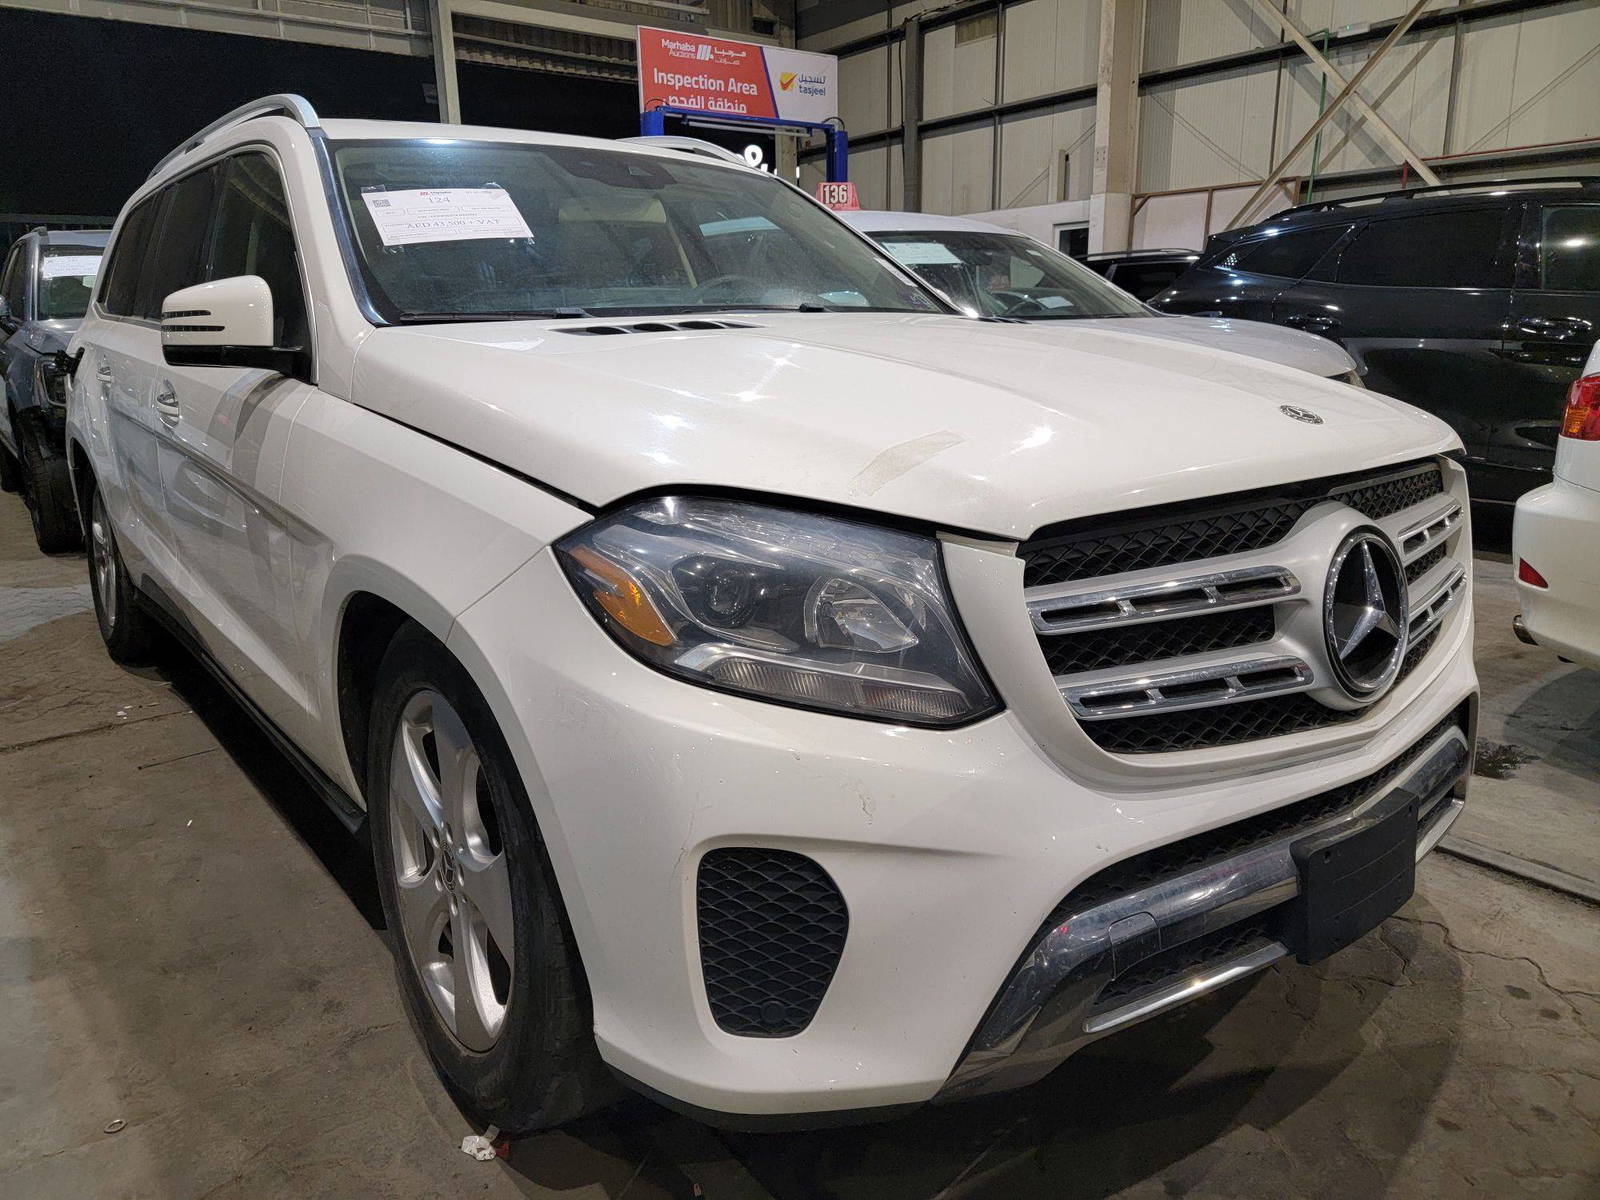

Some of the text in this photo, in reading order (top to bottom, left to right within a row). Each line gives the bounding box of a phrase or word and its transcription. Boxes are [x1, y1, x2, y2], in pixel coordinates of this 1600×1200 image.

[661, 38, 696, 53] Marhaba
[653, 68, 758, 96] Inspection Area
[799, 84, 826, 97] tasjeel
[707, 96, 747, 114] منطقة
[823, 185, 848, 204] 136
